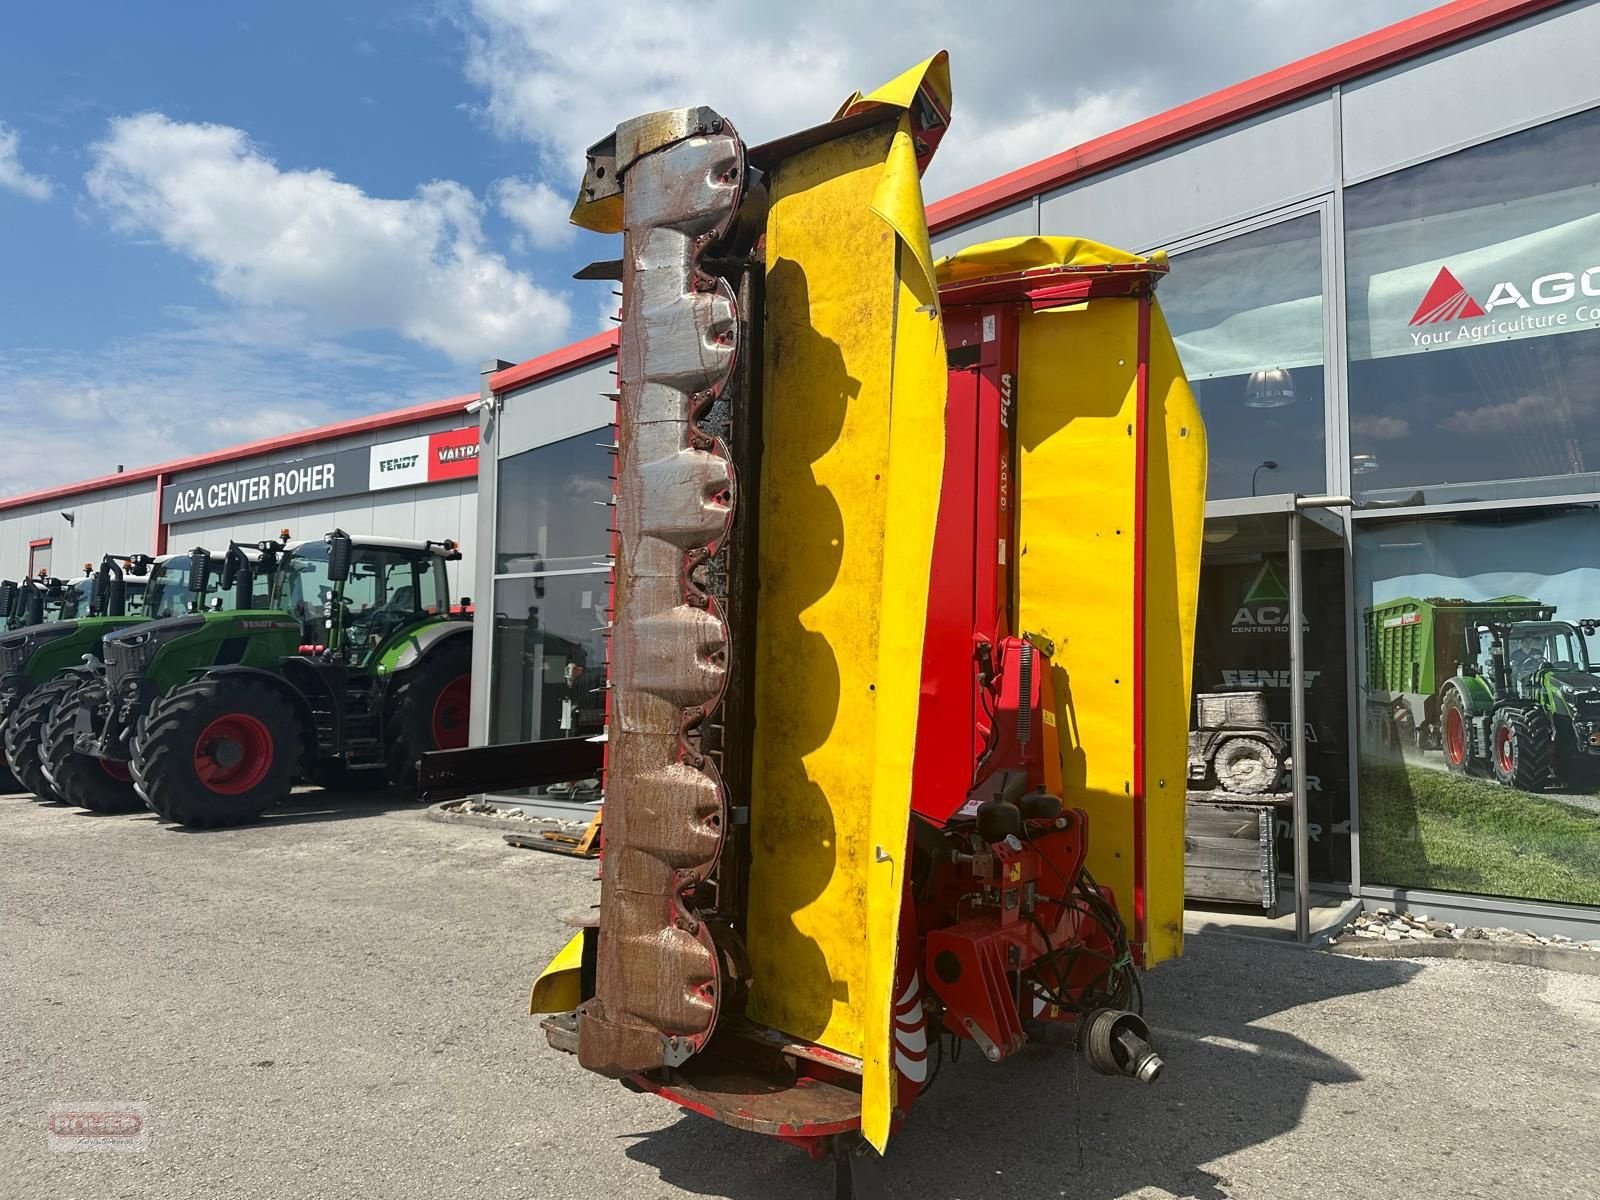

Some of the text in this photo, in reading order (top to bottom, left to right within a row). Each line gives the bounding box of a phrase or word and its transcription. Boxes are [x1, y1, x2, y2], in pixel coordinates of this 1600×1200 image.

[1410, 306, 1600, 346] Your Agriculture Co
[379, 455, 419, 473] FENDT
[174, 463, 336, 515] ACA CENTER ROHER
